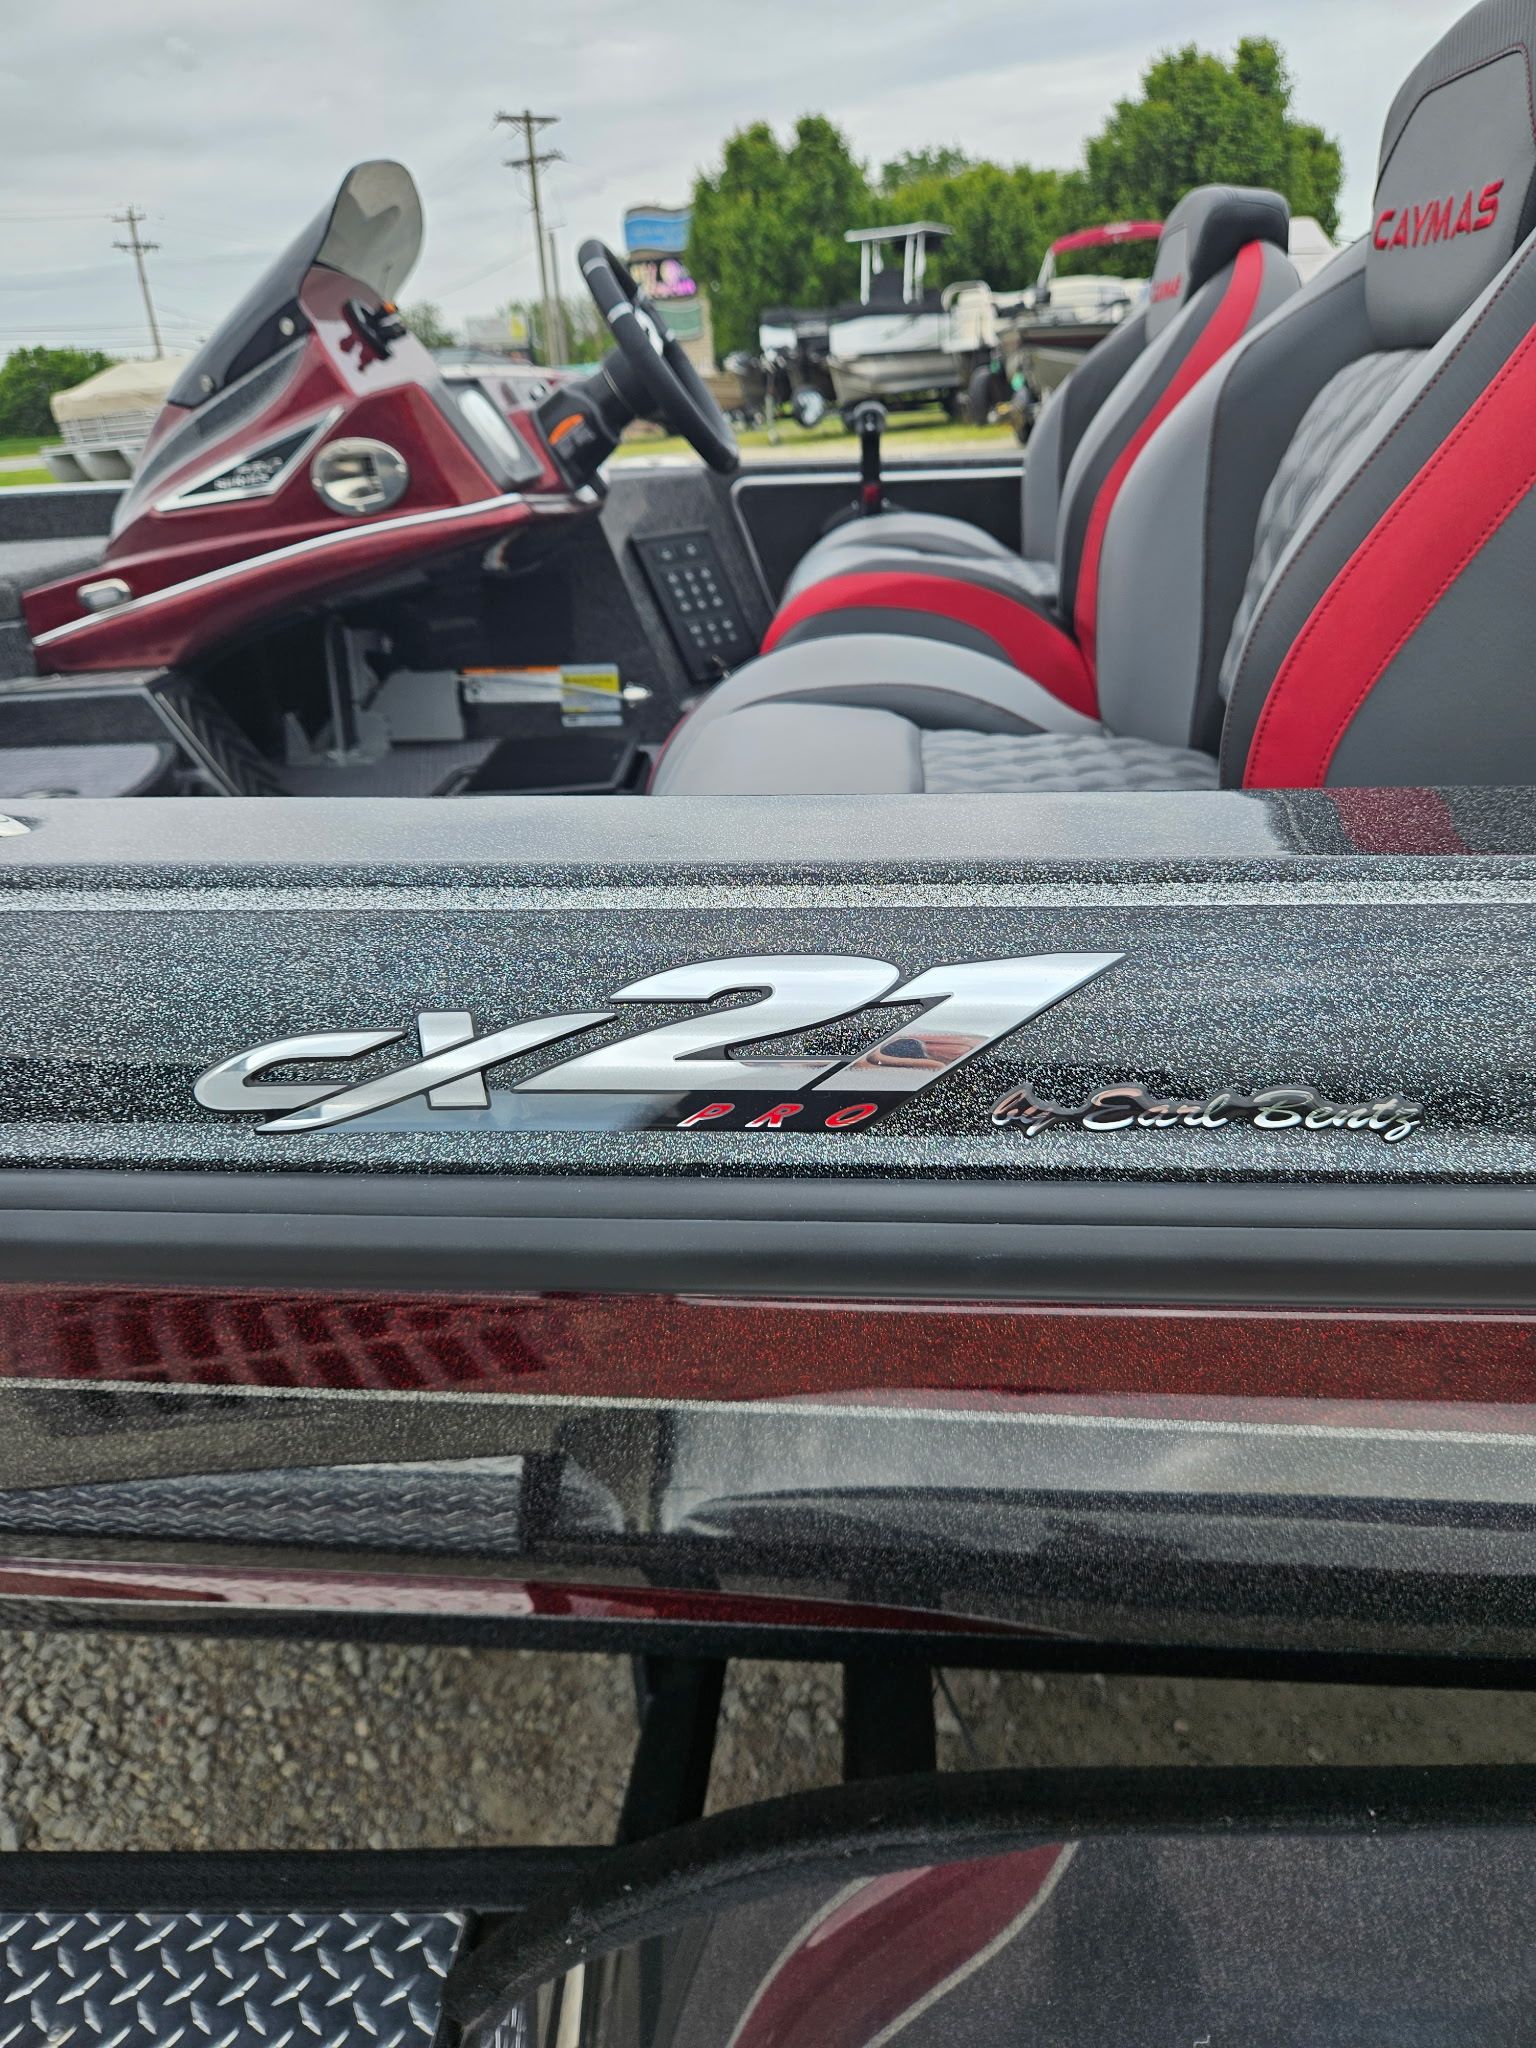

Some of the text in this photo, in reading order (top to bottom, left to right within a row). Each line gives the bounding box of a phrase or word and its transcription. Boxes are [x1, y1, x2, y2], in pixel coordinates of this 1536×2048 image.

[1373, 178, 1504, 251] CAYMAS
[677, 1102, 876, 1128] PRO
[991, 1087, 1422, 1143] by Earl Bentz
